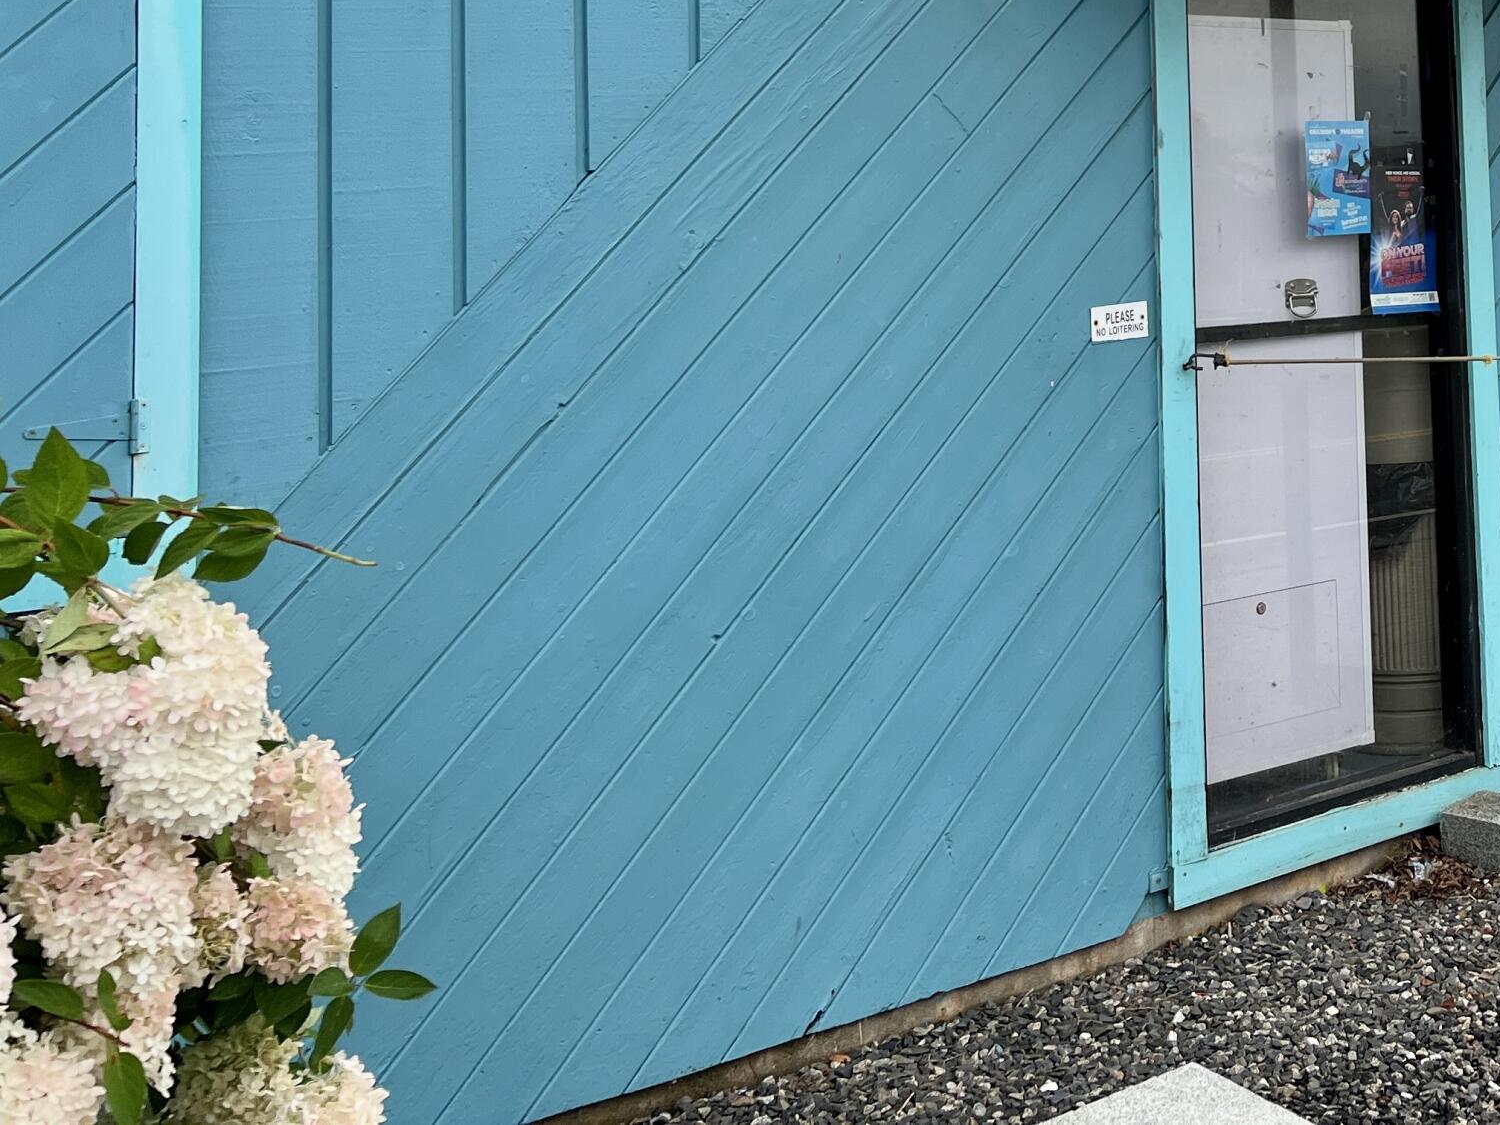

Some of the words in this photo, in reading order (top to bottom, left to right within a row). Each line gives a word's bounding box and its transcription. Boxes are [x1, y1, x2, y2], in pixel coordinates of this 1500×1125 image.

[1396, 242, 1425, 259] YOUR
[1105, 309, 1135, 325] PLEASE
[1096, 327, 1106, 337] NO
[1108, 322, 1144, 336] LOITERING
